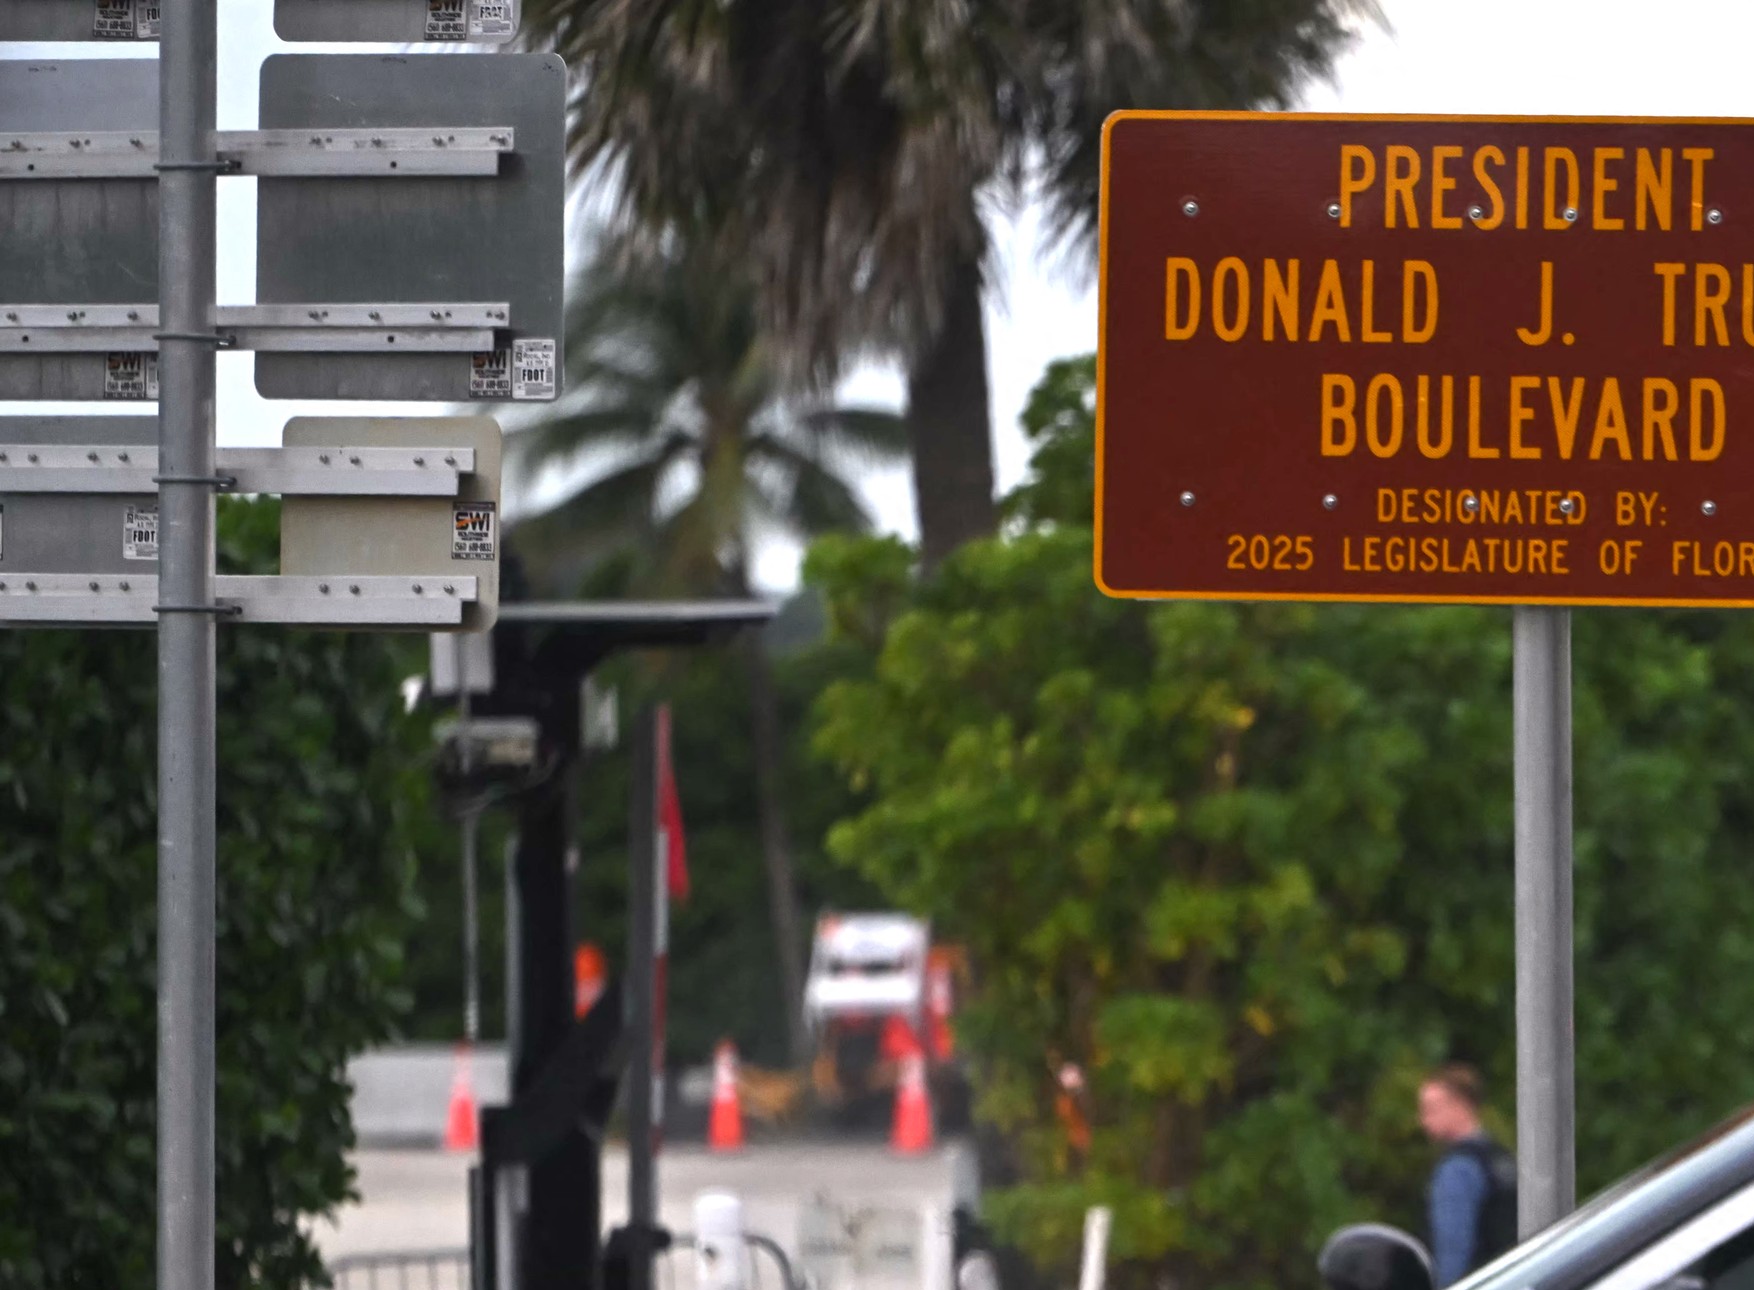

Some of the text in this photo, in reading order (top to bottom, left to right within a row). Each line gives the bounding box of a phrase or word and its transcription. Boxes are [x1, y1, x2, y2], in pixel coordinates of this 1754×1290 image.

[1338, 144, 1716, 232] PRESIDENT
[1164, 256, 1440, 344] DONALD
[1516, 261, 1577, 347] J.
[522, 368, 545, 382] FDOT
[1321, 372, 1727, 461] BOULEVARD
[455, 511, 490, 531] SWI
[1377, 488, 1669, 527] DESIGNATED BY:
[133, 530, 155, 542] FDOT
[1227, 534, 1314, 571] 2025
[1343, 536, 1570, 575] LEGISLATURE
[1599, 539, 1643, 575] OF
